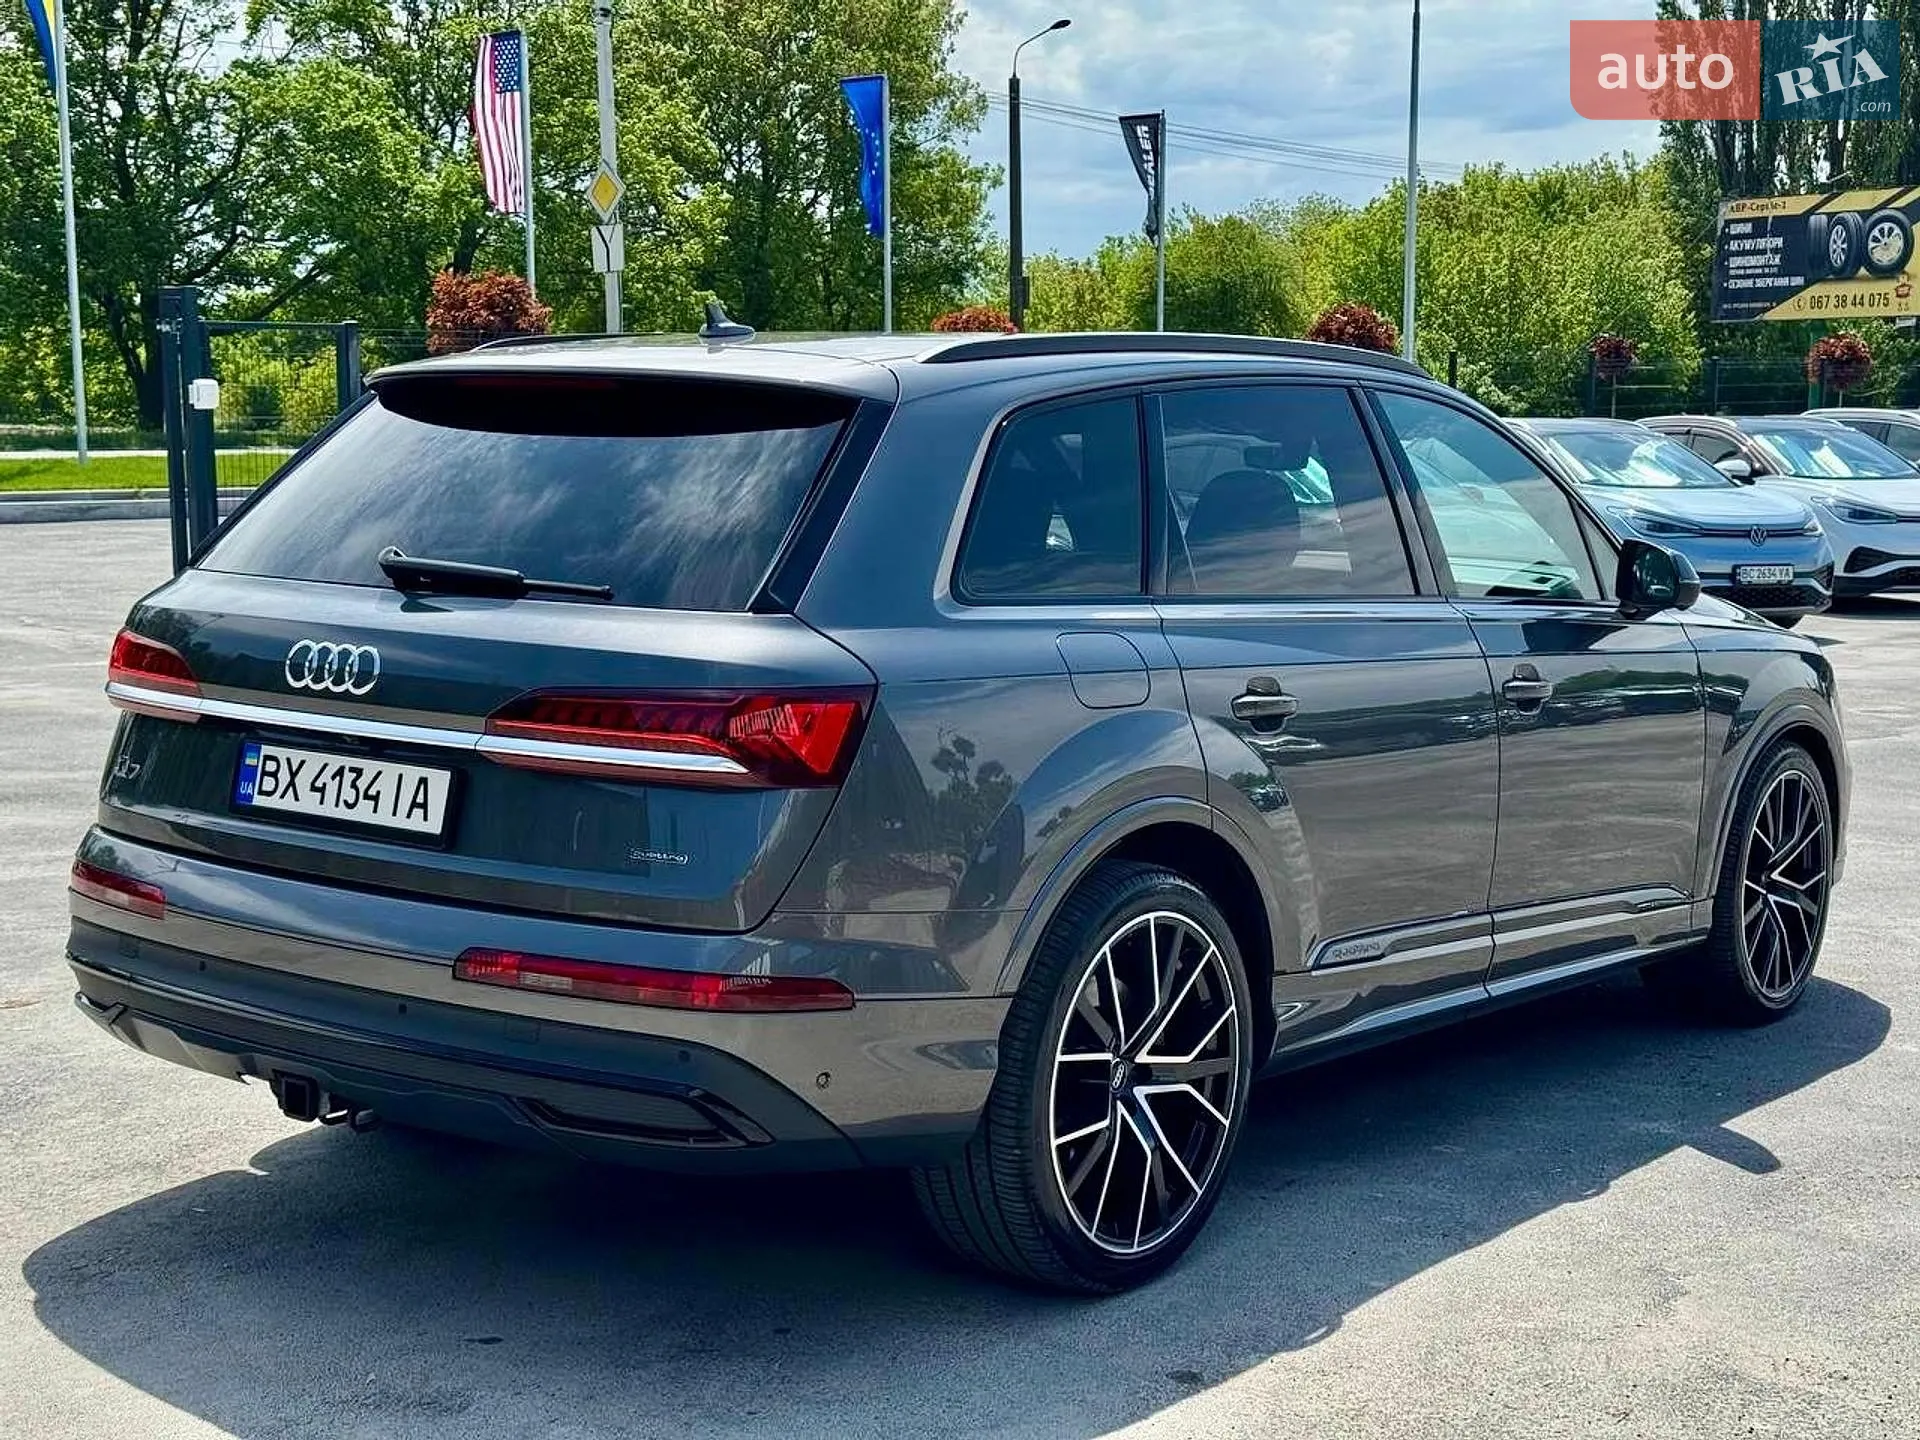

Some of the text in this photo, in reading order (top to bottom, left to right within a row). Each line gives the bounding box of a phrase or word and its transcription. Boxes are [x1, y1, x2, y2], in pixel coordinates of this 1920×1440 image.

[1810, 292, 1890, 309] 067 38 44 075
[239, 781, 254, 796] UA
[257, 755, 429, 822] BX 4134 IA
